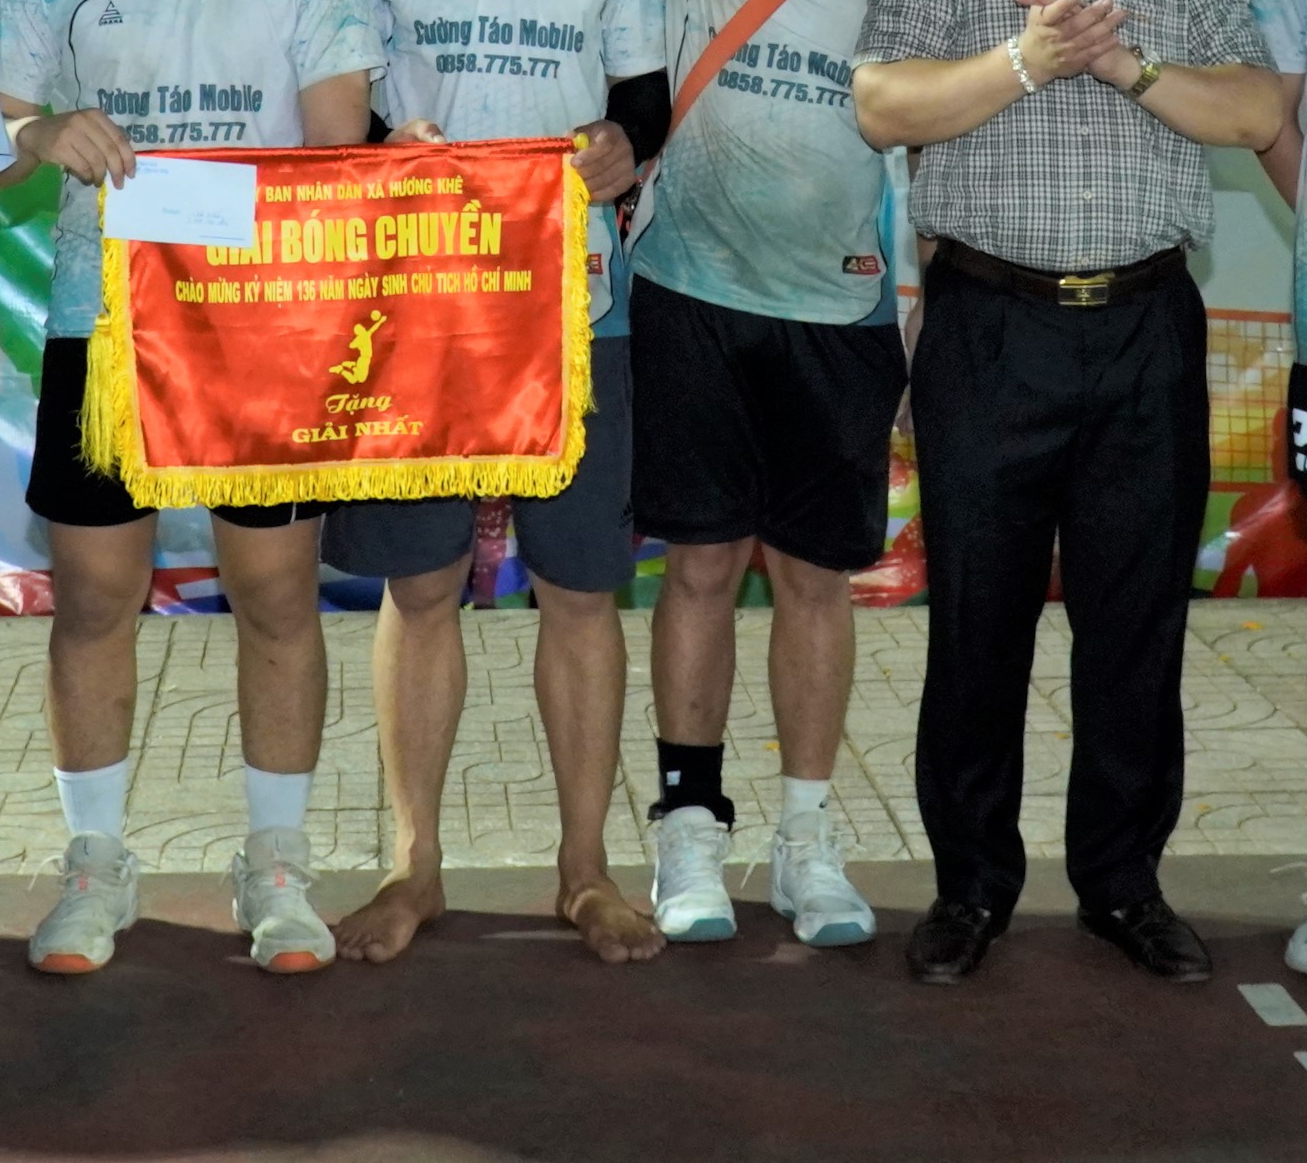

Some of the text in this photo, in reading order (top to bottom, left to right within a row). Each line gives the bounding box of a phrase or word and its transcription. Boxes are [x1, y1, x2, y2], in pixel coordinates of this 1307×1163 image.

[478, 16, 513, 44] Táo
[519, 18, 584, 53] Mobile
[436, 53, 560, 78] 0858.775.777
[767, 42, 802, 73] Táo
[808, 51, 852, 87] Mob
[158, 85, 191, 113] Táo
[199, 84, 263, 112] Mobile
[718, 68, 851, 107] 0858.775.777
[265, 185, 292, 202] BAN
[297, 181, 332, 201] NHÂN
[367, 179, 384, 199] XÃ
[389, 176, 433, 197] HƯƠNG
[437, 175, 463, 194] KHÊ
[280, 210, 368, 263] BÓNG
[375, 199, 502, 260] CHUYỀN
[175, 277, 205, 303] CHÀO
[208, 277, 241, 303] MỪNG
[244, 274, 261, 303] KỶ
[264, 276, 293, 308] NIỆM
[297, 280, 316, 301] 136
[348, 272, 379, 299] NGÀY
[382, 273, 407, 296] SINH
[411, 265, 433, 294] CHỦ
[463, 265, 478, 292] HỒ
[481, 266, 500, 292] CHÍ
[504, 270, 531, 292] MINH
[325, 394, 393, 415] Tặng
[292, 415, 423, 443] GIẢI NHẤT
